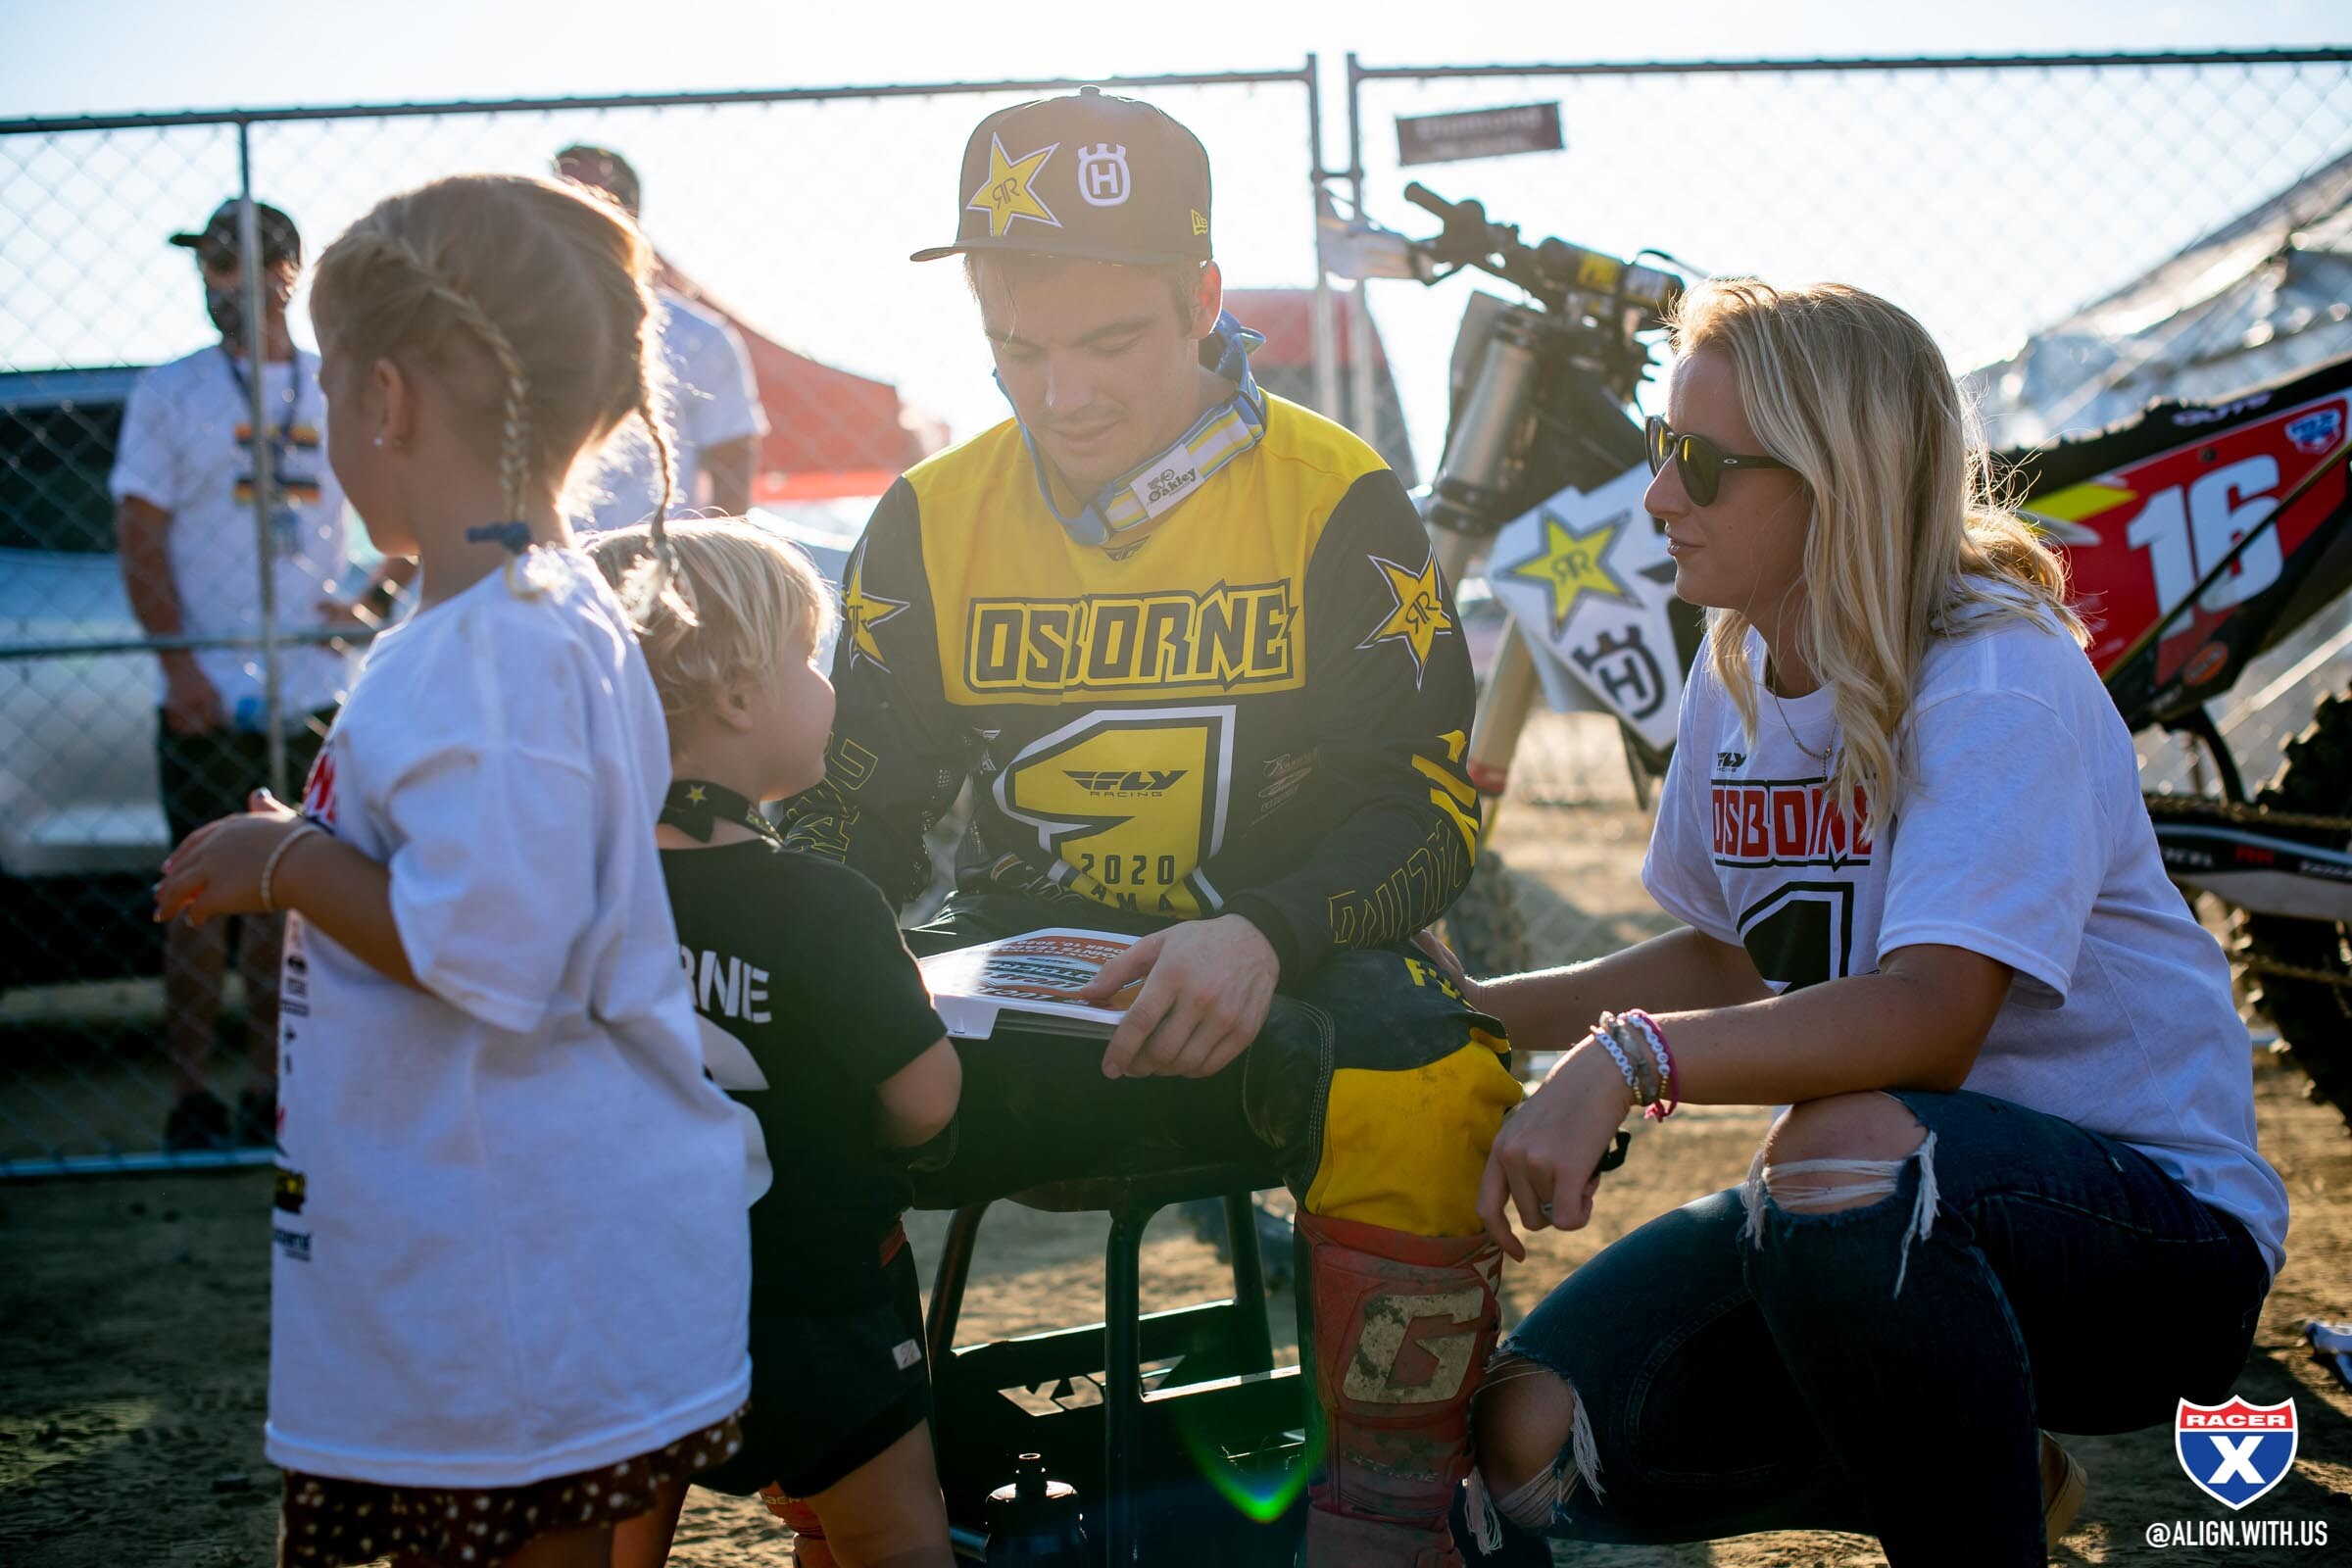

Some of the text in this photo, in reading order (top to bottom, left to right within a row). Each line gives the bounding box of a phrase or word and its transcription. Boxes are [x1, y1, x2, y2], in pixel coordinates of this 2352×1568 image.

[1149, 467, 1197, 503] Oakley
[2126, 454, 2284, 638] 16
[1086, 769, 1189, 791] FLY
[1711, 786, 1873, 858] OSBON
[1081, 853, 1175, 885] 2020
[1061, 947, 1119, 958] OINTS
[1087, 944, 1128, 954] OBER
[978, 985, 1054, 1000] LUCA
